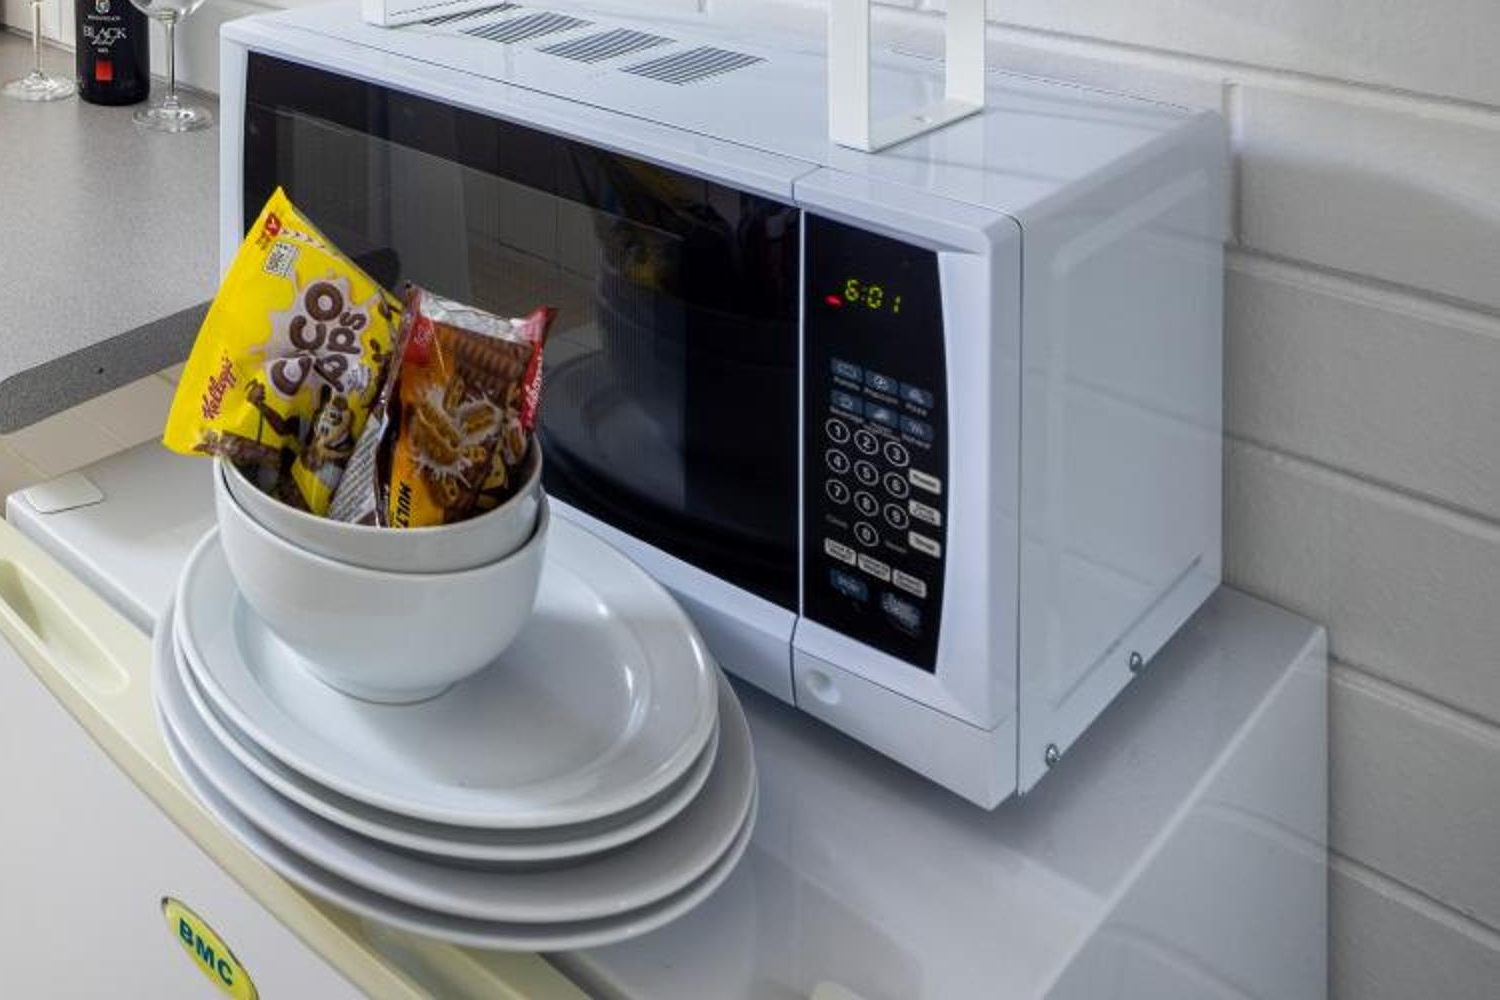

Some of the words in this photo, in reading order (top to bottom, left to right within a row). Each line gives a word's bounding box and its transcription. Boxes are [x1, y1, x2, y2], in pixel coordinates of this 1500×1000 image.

[83, 26, 128, 40] BLACK
[844, 279, 901, 313] 6:01
[269, 281, 344, 396] CCO
[395, 479, 413, 528] MULT
[179, 916, 233, 986] BMC
